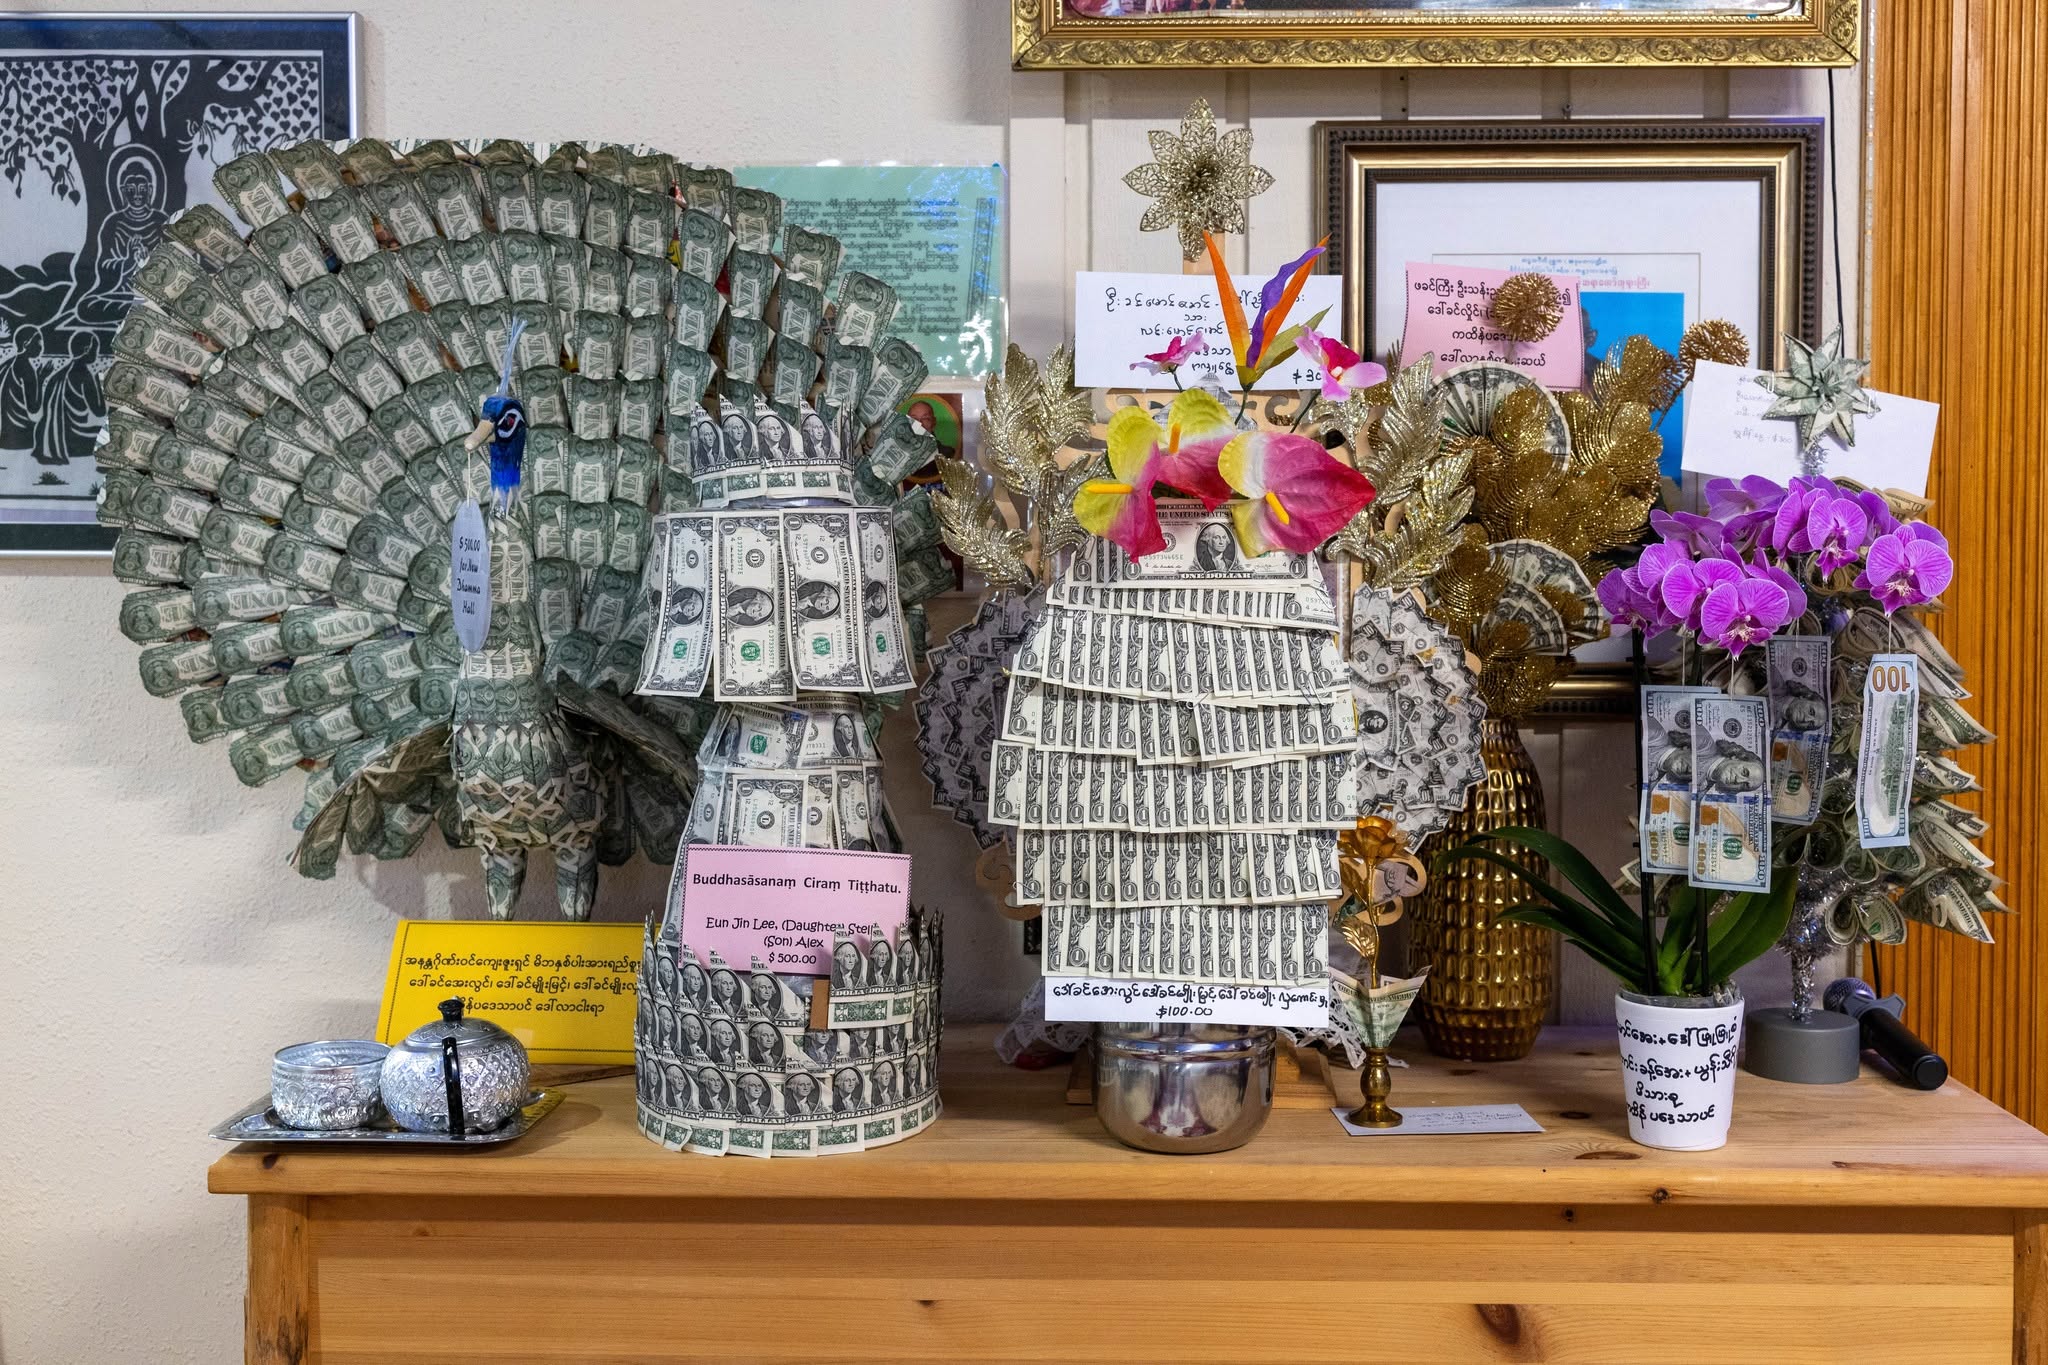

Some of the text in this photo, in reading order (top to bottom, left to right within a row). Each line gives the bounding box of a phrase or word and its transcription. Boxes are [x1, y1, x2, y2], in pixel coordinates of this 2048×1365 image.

[841, 557, 850, 585] UNITED
[462, 601, 475, 615] Hall
[661, 597, 671, 639] DOLLAR
[1872, 665, 1911, 693] 100
[706, 917, 729, 929] Eun
[731, 917, 749, 930] Jin
[753, 918, 778, 931] Lee,
[763, 936, 824, 948] (Son) Alex
[777, 953, 817, 965] 500.00
[1156, 1005, 1213, 1019] $100.00
